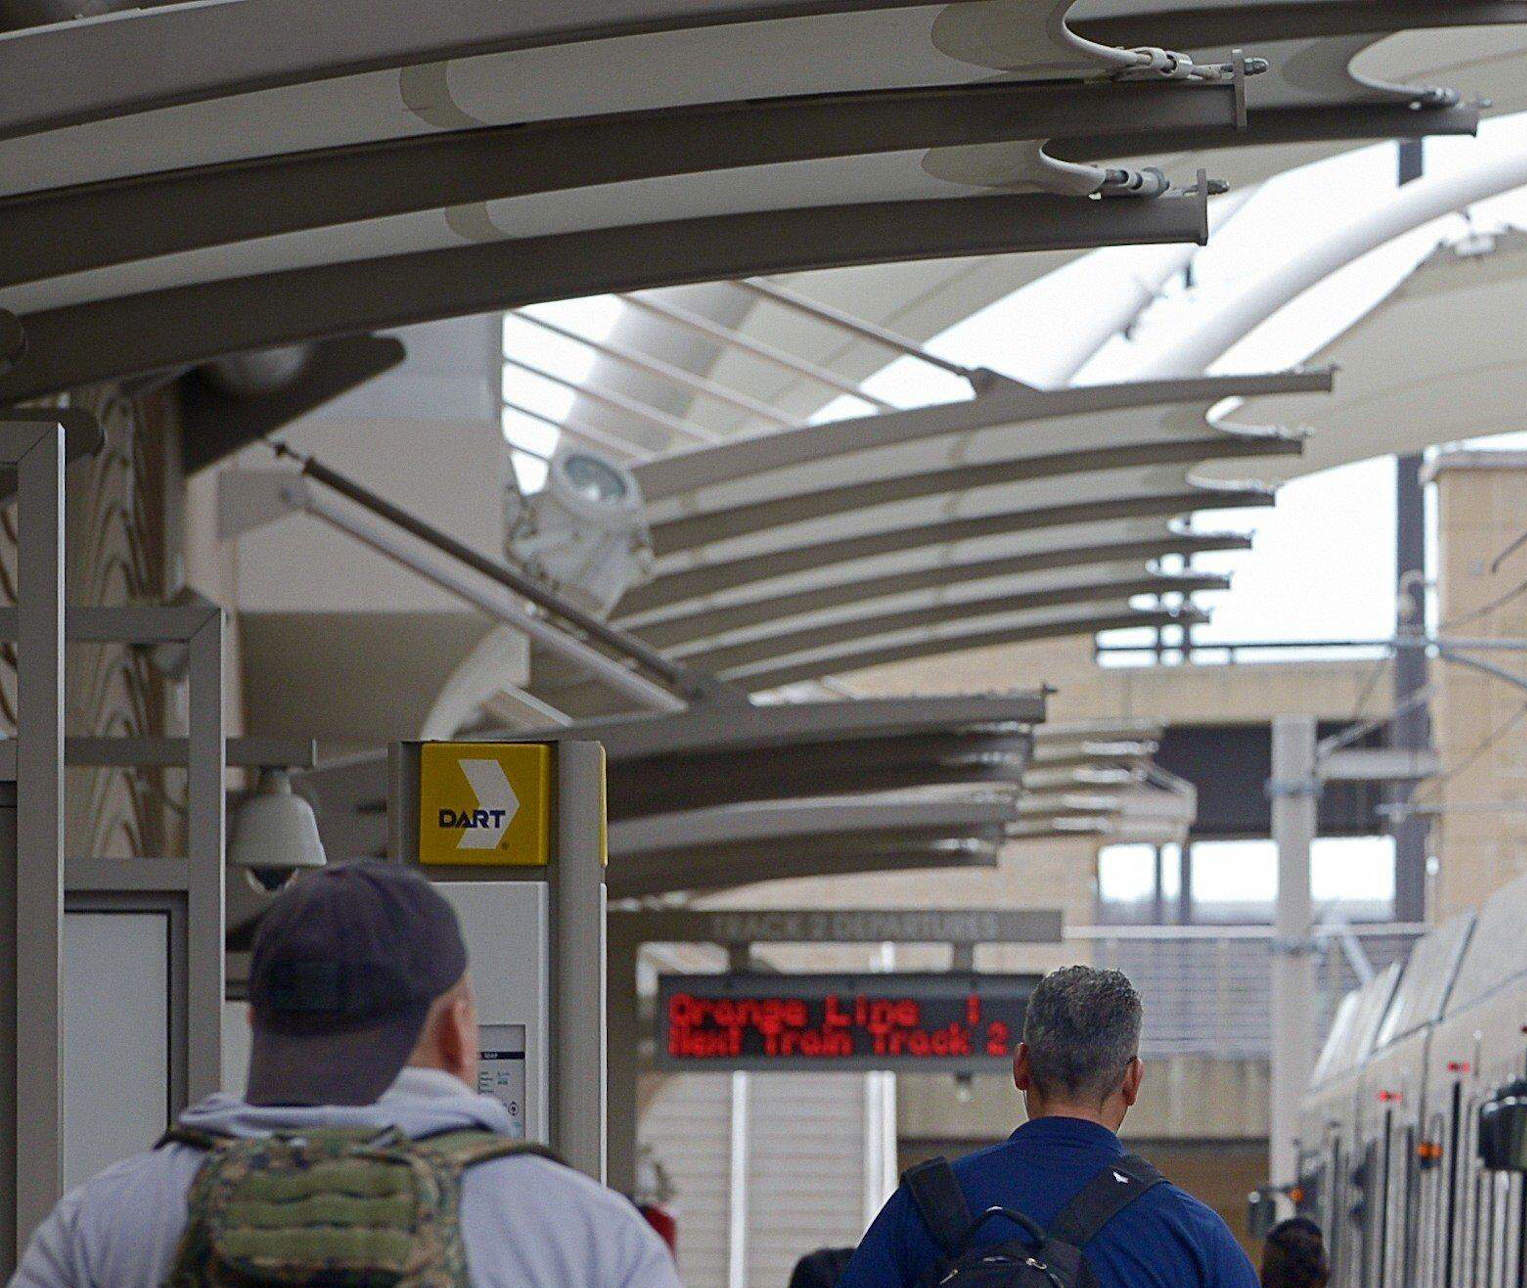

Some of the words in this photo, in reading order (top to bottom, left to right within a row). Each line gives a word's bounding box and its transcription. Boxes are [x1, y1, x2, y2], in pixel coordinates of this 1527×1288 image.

[438, 808, 506, 829] DART
[668, 993, 806, 1035] Orange
[825, 994, 919, 1026] Line
[759, 1022, 854, 1057] Train
[868, 1021, 972, 1057] Track
[986, 1020, 1009, 1057] 2
